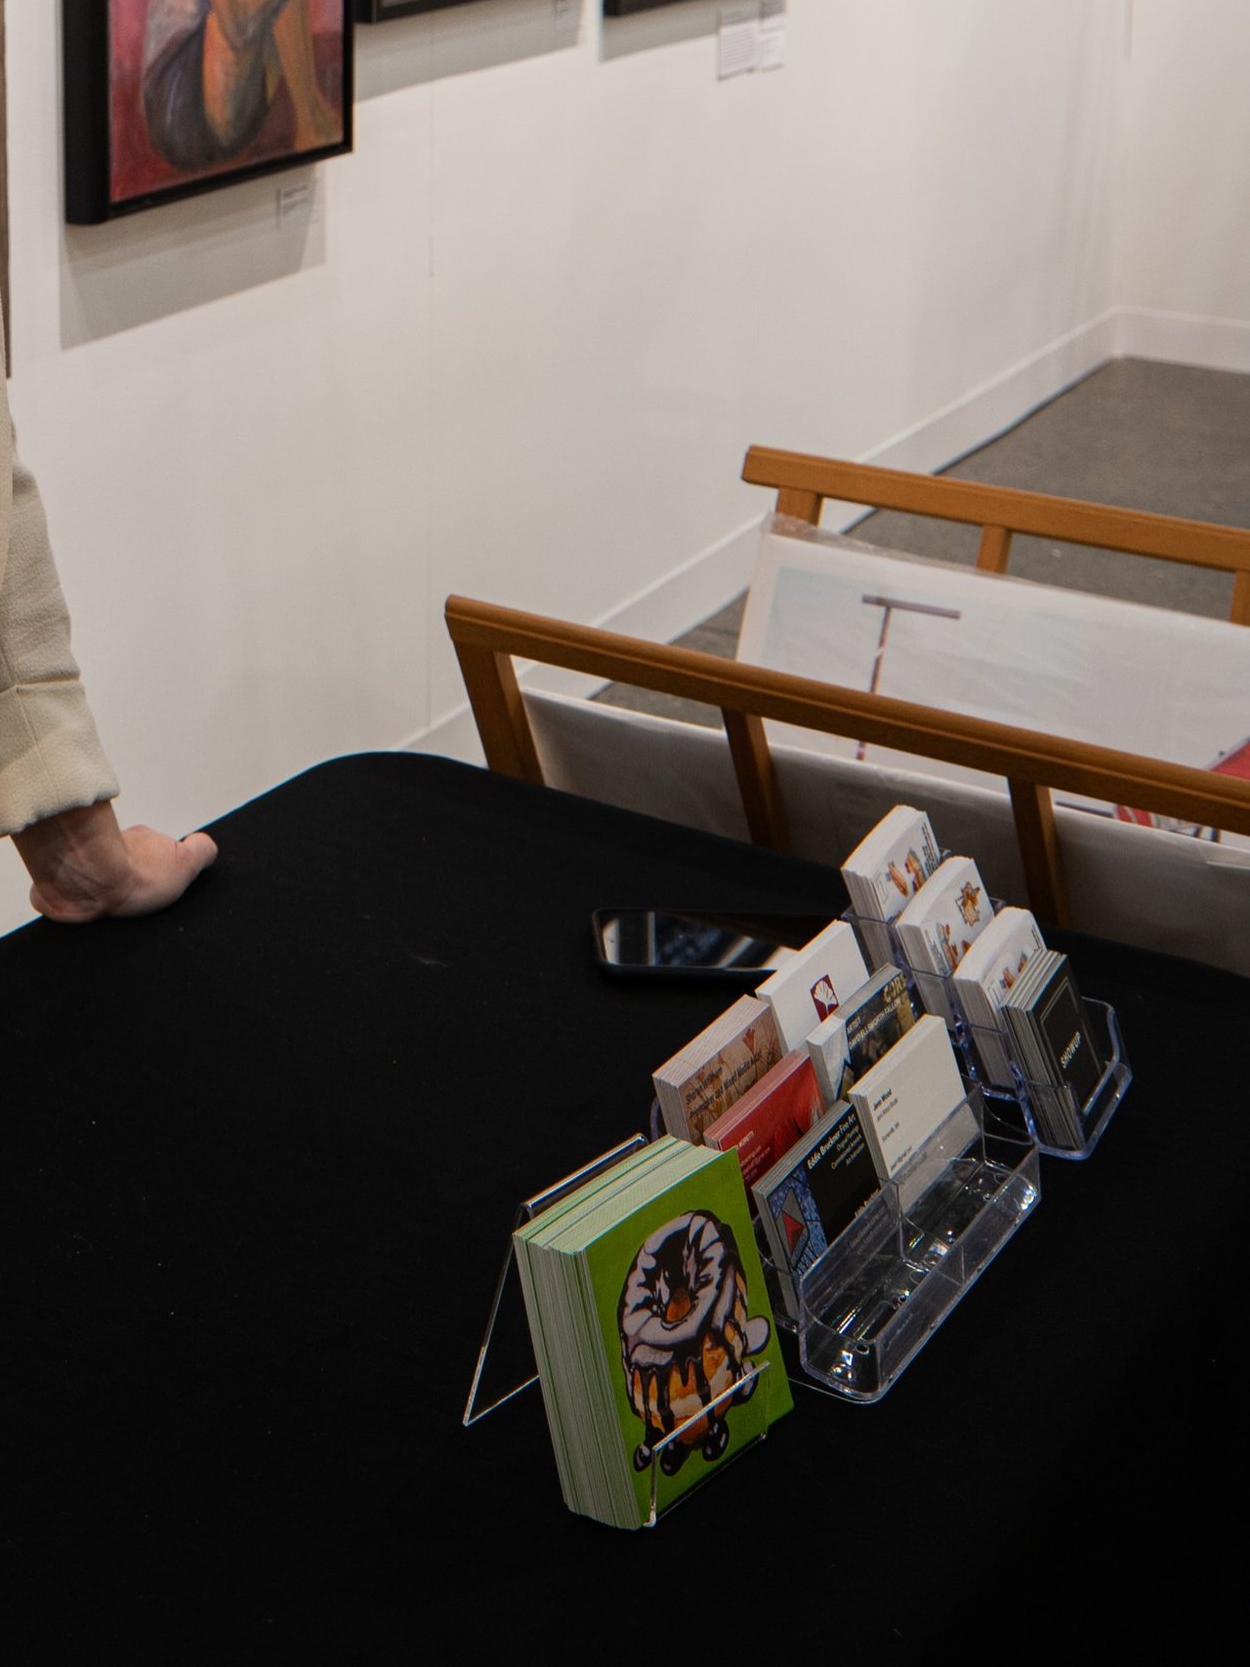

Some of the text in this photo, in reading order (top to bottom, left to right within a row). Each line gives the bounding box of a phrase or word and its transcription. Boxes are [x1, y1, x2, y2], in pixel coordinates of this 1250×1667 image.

[1060, 1031, 1081, 1069] SHOWUP
[873, 1088, 892, 1111] Jenn Wood
[807, 1113, 857, 1170] Eddie Bruckner Fine Art
